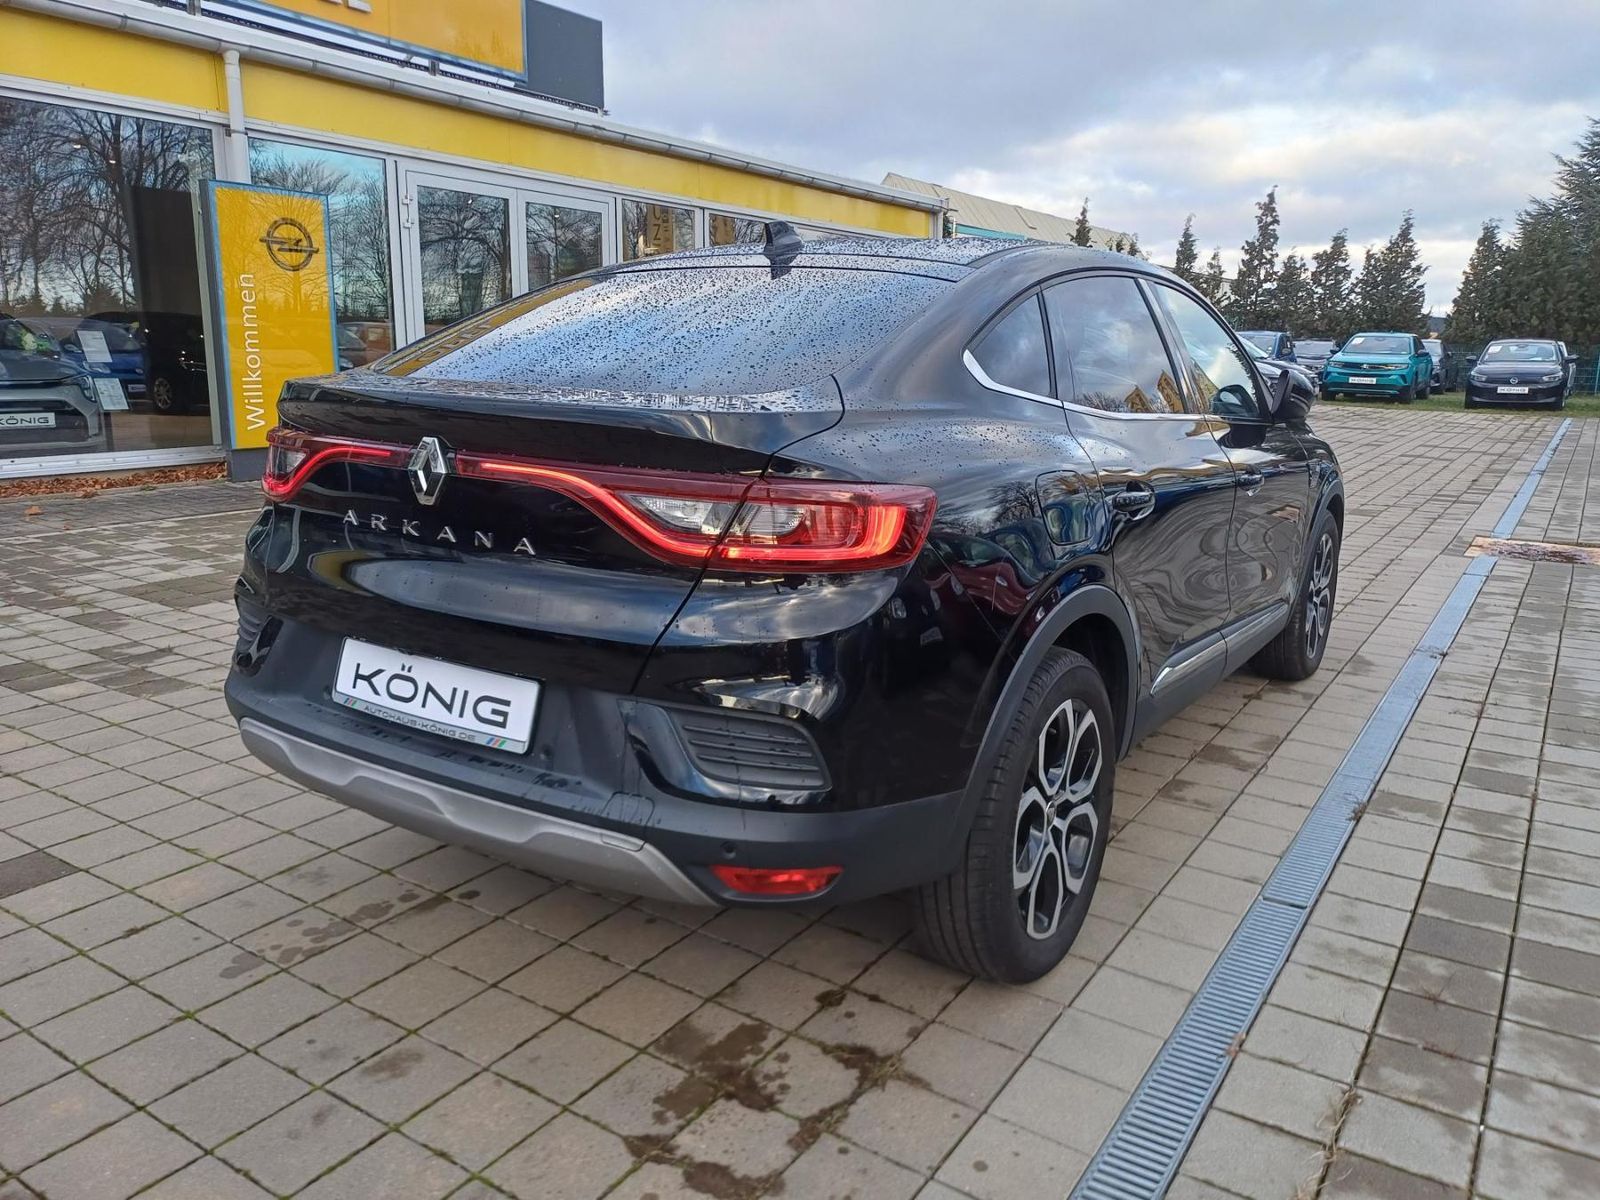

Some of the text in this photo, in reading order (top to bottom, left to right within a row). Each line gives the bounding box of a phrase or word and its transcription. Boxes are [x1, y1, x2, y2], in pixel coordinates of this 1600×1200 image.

[240, 273, 265, 430] Willkommen
[343, 509, 536, 556] ARKANA
[352, 662, 511, 729] KÖNIG
